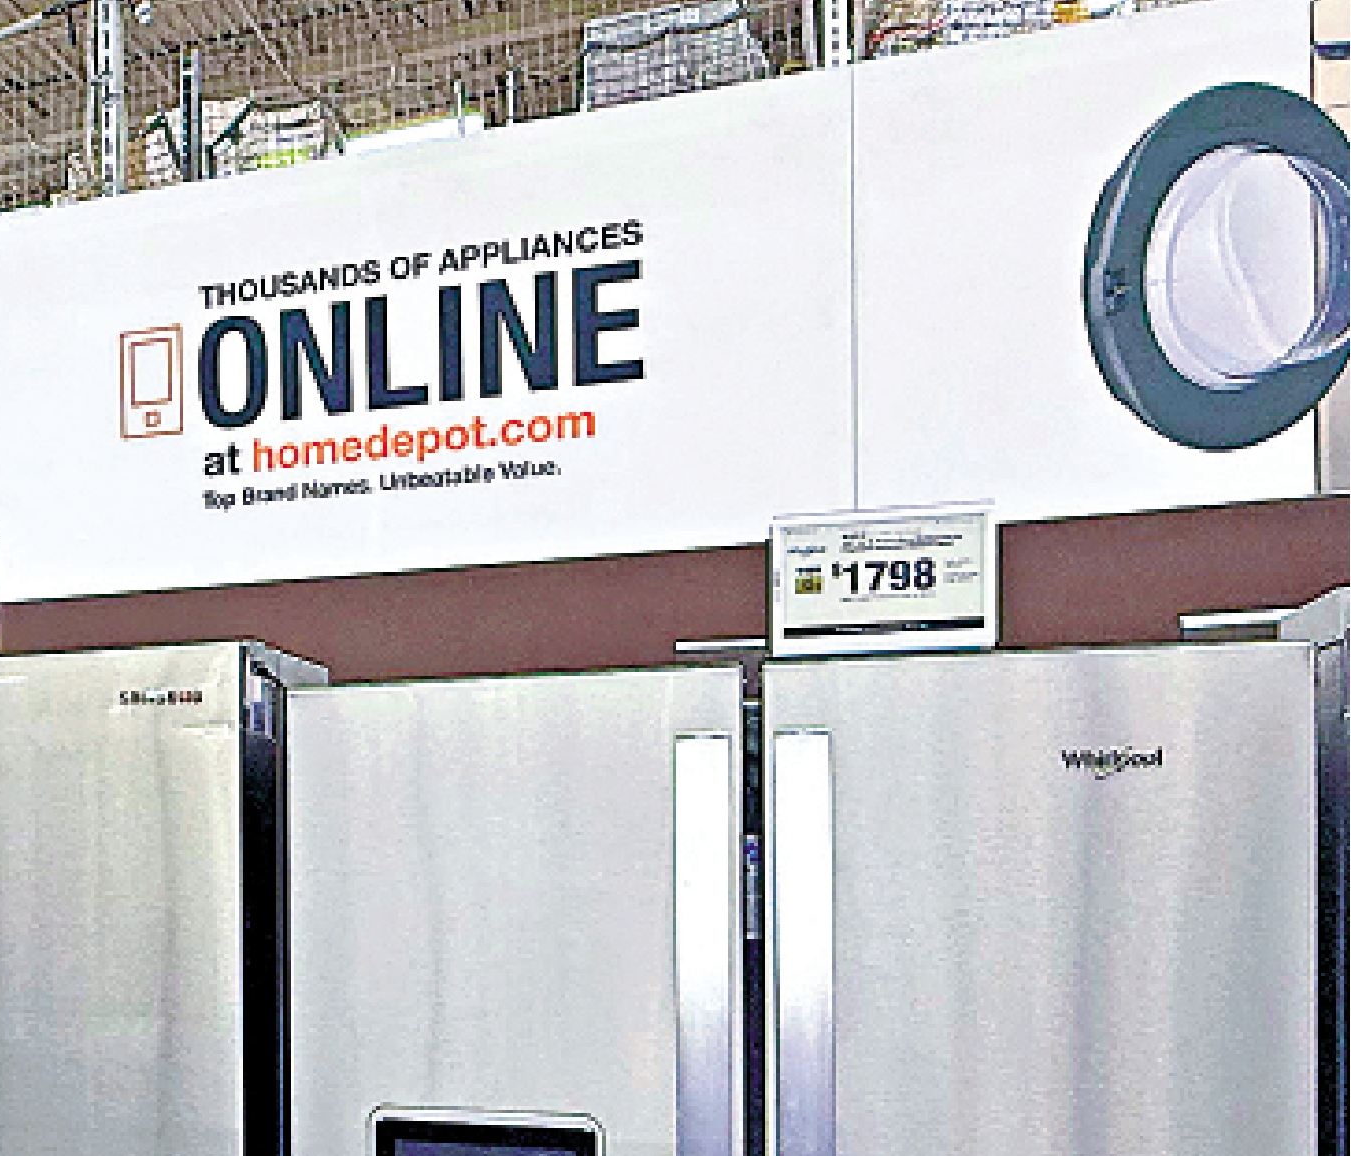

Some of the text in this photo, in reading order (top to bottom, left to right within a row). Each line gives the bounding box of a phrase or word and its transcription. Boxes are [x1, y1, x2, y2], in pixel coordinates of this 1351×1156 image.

[198, 219, 644, 309] THOUSANDS OF APPLIANCES
[198, 259, 645, 430] ONLINE
[204, 411, 597, 475] at homedepot.com
[203, 489, 236, 513] Top
[242, 483, 297, 507] Brand
[379, 463, 496, 492] Unbeatable
[832, 557, 937, 595] $1798
